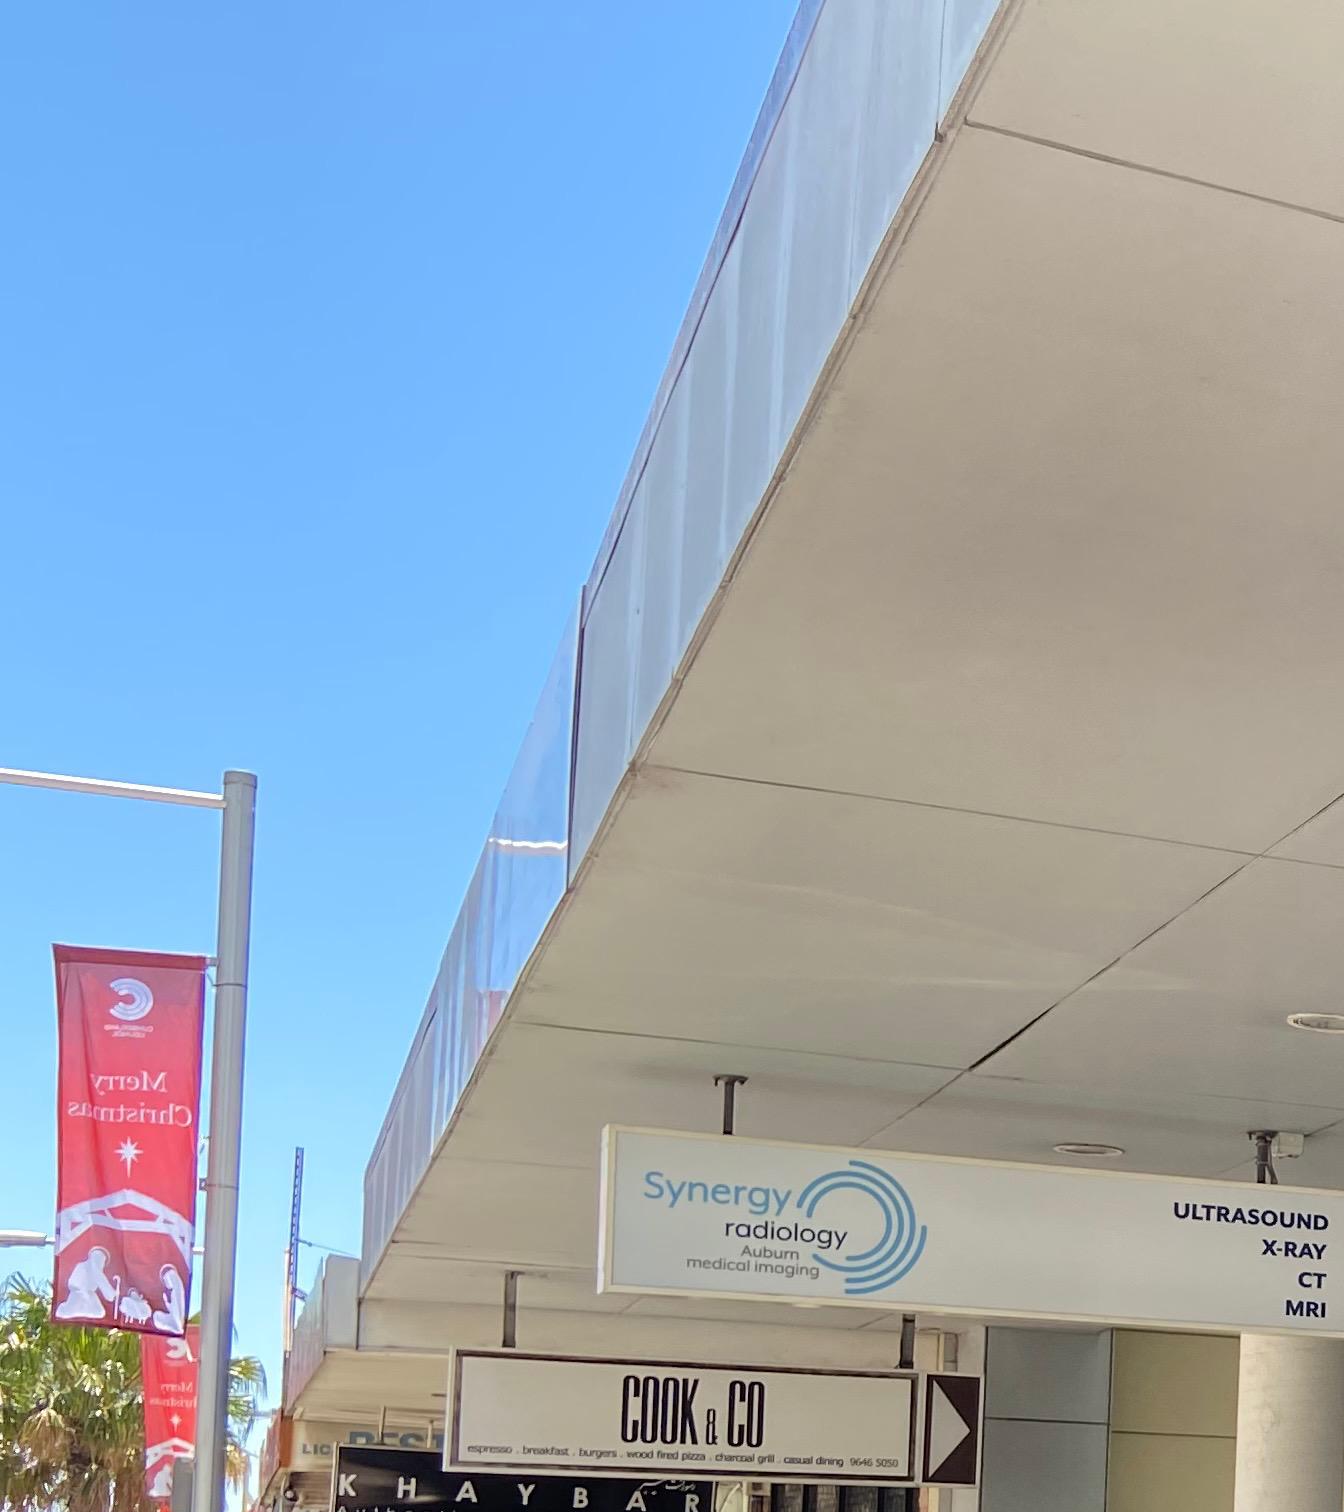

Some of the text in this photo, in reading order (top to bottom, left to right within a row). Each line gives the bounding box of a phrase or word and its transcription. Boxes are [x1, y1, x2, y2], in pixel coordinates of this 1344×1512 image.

[643, 1171, 792, 1217] Synergy
[1174, 1202, 1329, 1231] ULTRASOUND
[725, 1220, 848, 1250] radiology
[740, 1245, 800, 1261] Auburn
[1261, 1239, 1327, 1260] X-RAY
[686, 1258, 820, 1280] medical imaging
[1298, 1272, 1327, 1289] CT
[1285, 1299, 1326, 1318] MRI
[620, 1375, 765, 1448] COOK & CO
[467, 1445, 899, 1468] espresso breakfast burgers wood fired pizza charcoal grill casual dining 9646 5050
